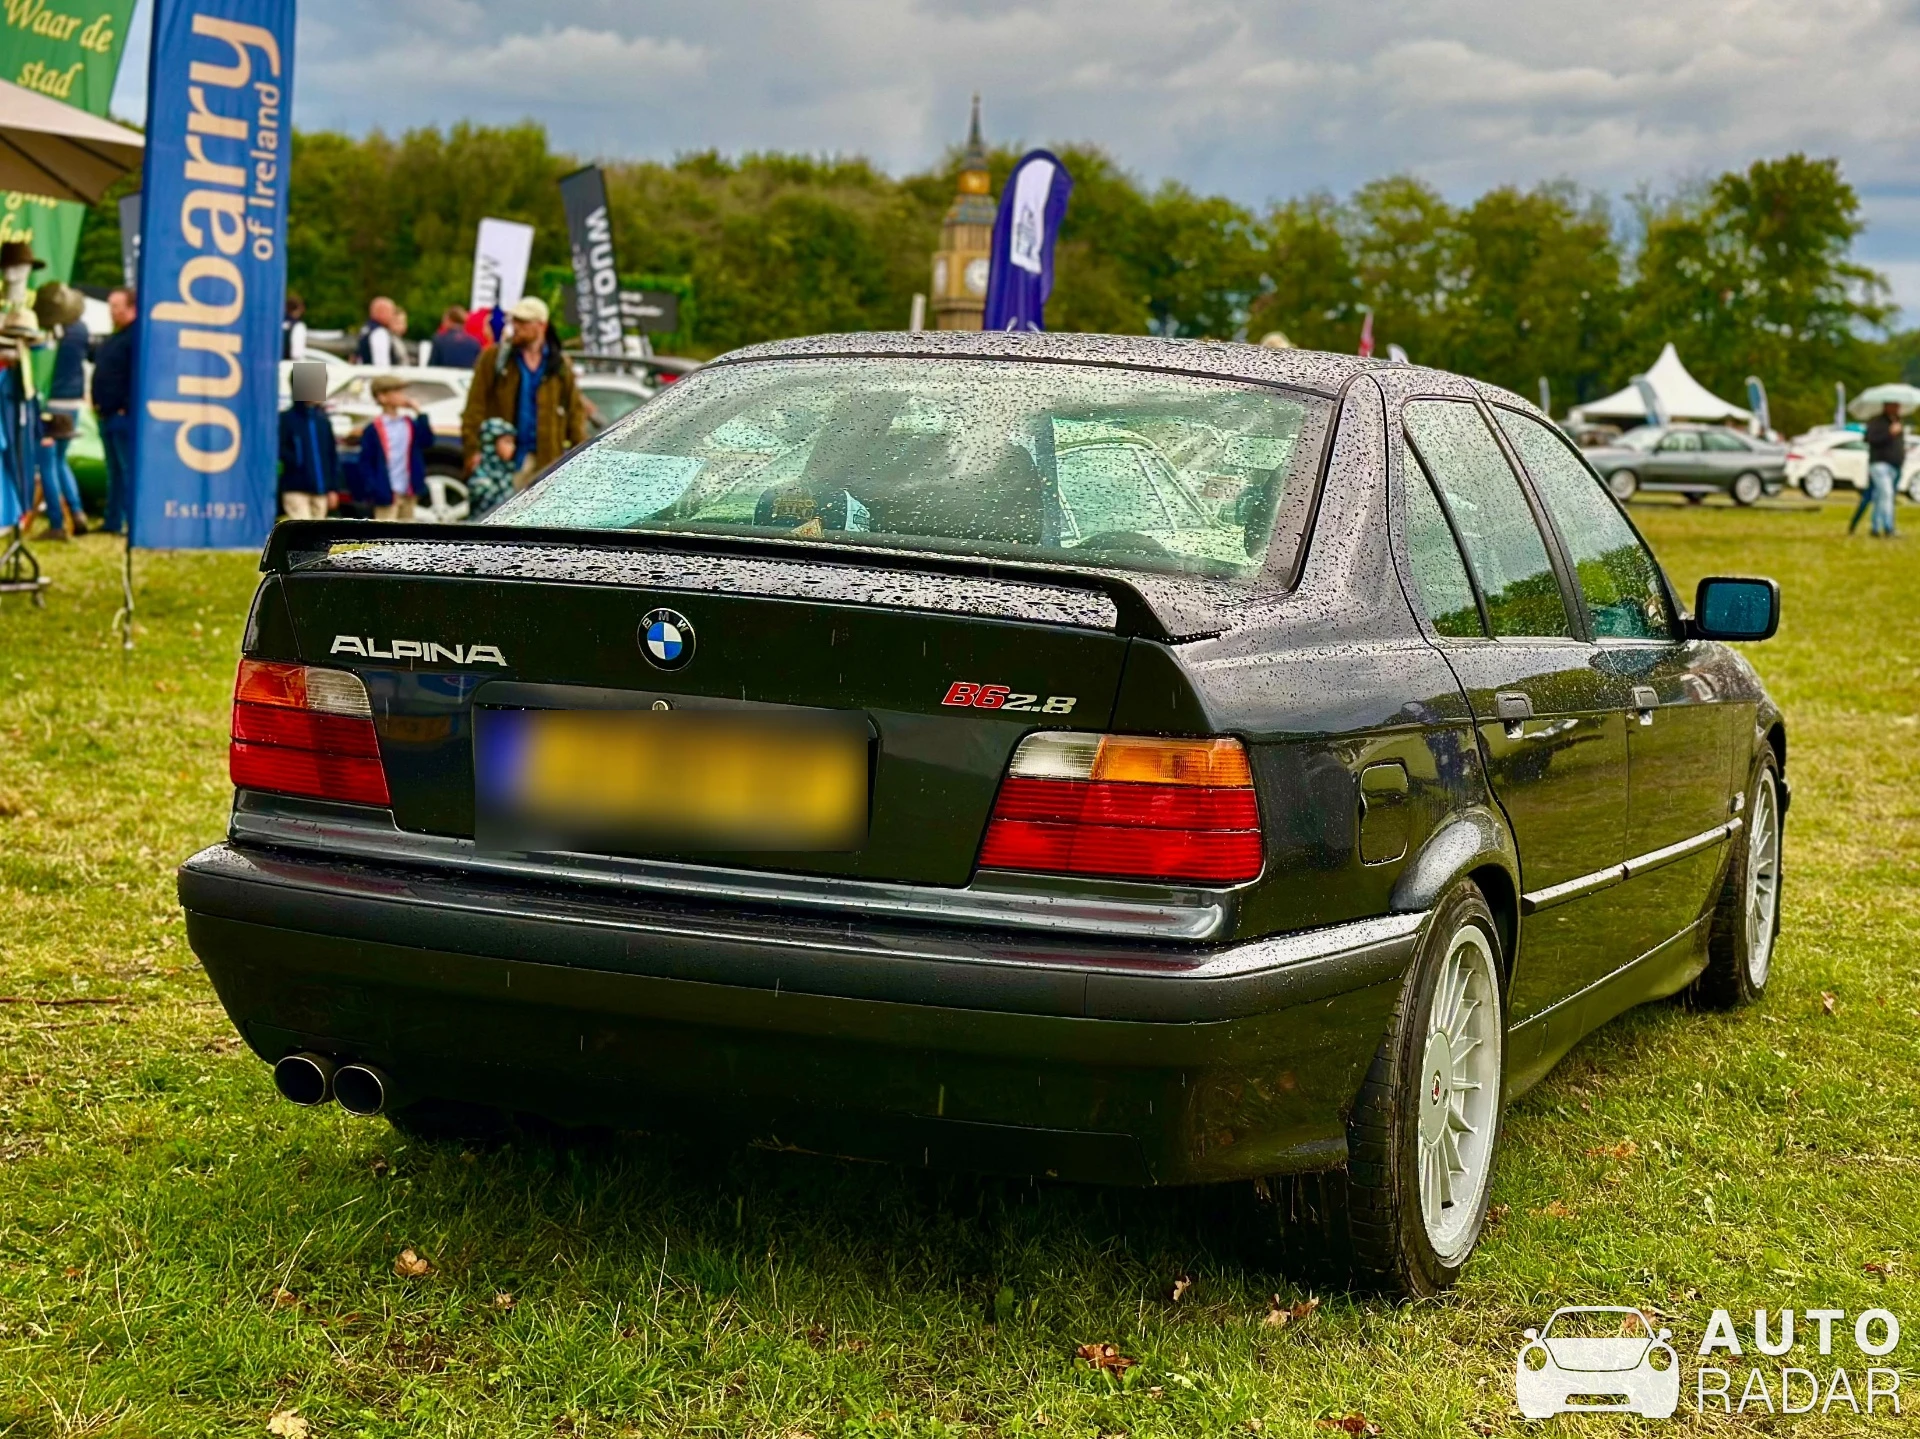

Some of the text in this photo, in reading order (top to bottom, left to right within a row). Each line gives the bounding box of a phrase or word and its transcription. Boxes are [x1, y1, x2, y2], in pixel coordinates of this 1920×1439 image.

[4, 0, 114, 53] Waar de
[17, 60, 84, 98] stad
[247, 82, 280, 260] of Ireland
[147, 14, 281, 474] dubarry
[642, 610, 690, 632] BMW
[330, 635, 508, 666] ALPINA
